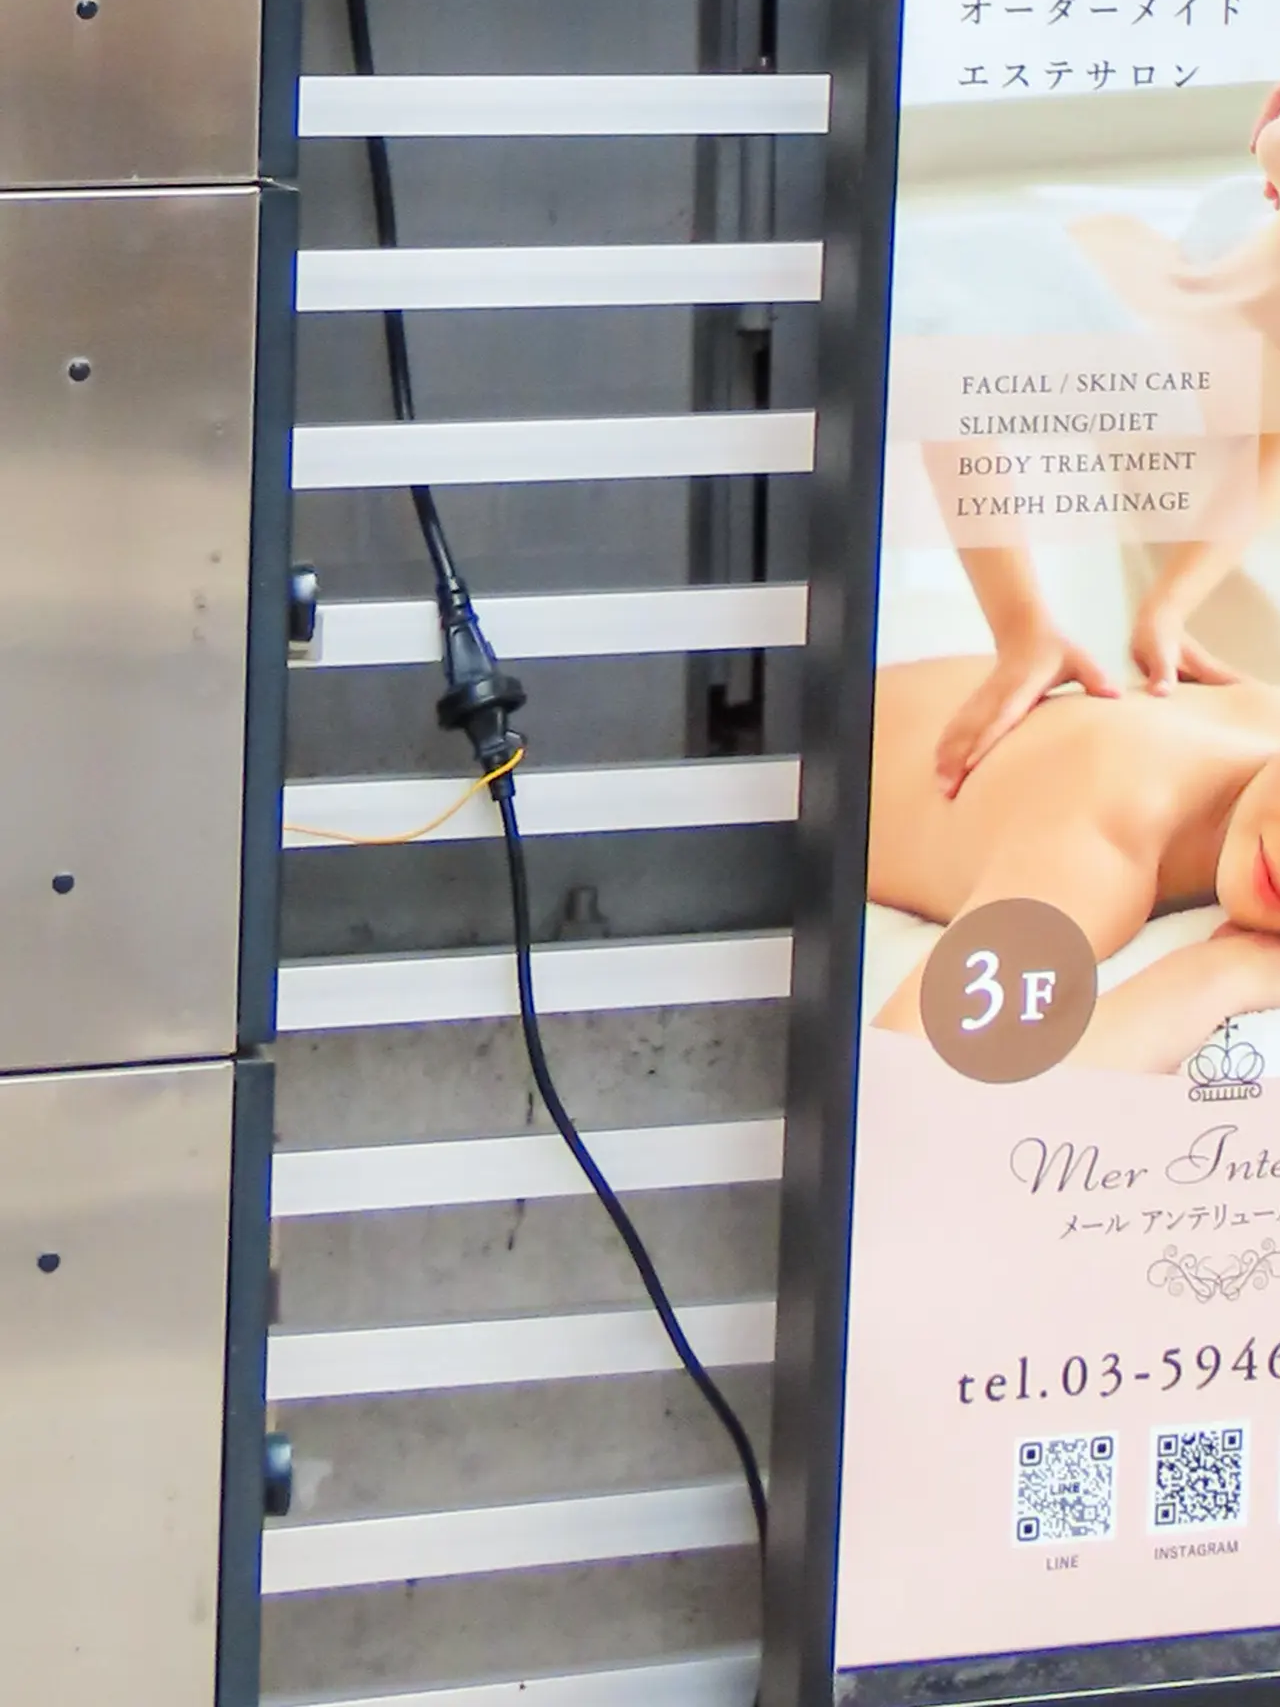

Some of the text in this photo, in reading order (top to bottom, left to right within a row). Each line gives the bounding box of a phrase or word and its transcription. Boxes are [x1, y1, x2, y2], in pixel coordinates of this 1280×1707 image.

[958, 60, 1200, 90] エステサロン
[961, 375, 1052, 395] FACIAL
[1076, 372, 1138, 393] SKIN
[1145, 371, 1212, 391] CARE
[959, 412, 1158, 435] SLIMMING/DIET
[958, 451, 1198, 476] BODY TREATMENT
[957, 491, 1191, 517] LYMPH DRAINAGE
[1010, 1136, 1148, 1195] Mer
[1059, 1214, 1131, 1240] メール
[1154, 1540, 1239, 1560] INSTAGRAM
[1046, 1555, 1079, 1571] LINE
